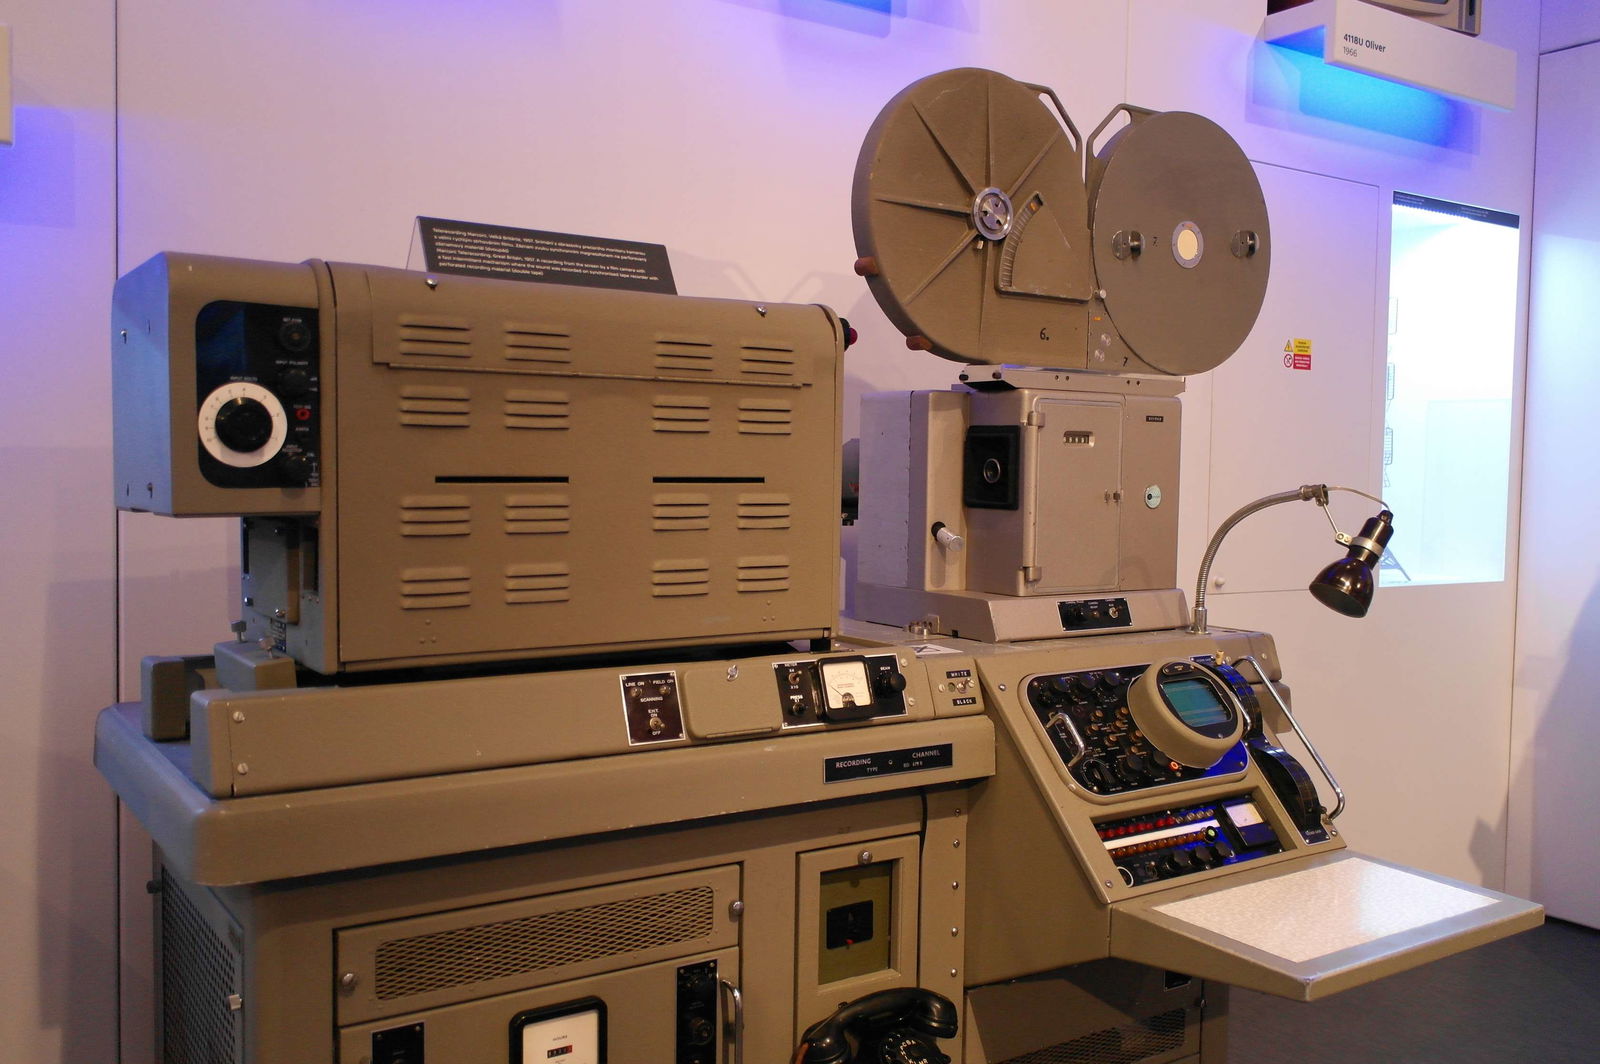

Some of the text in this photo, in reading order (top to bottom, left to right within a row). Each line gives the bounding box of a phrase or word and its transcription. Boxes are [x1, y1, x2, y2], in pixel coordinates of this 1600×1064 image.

[1344, 34, 1386, 52] 4118U Oliver
[1343, 46, 1358, 57] 1966
[1039, 327, 1050, 341] 6.
[835, 749, 941, 769] RECORDING CHANNEL
